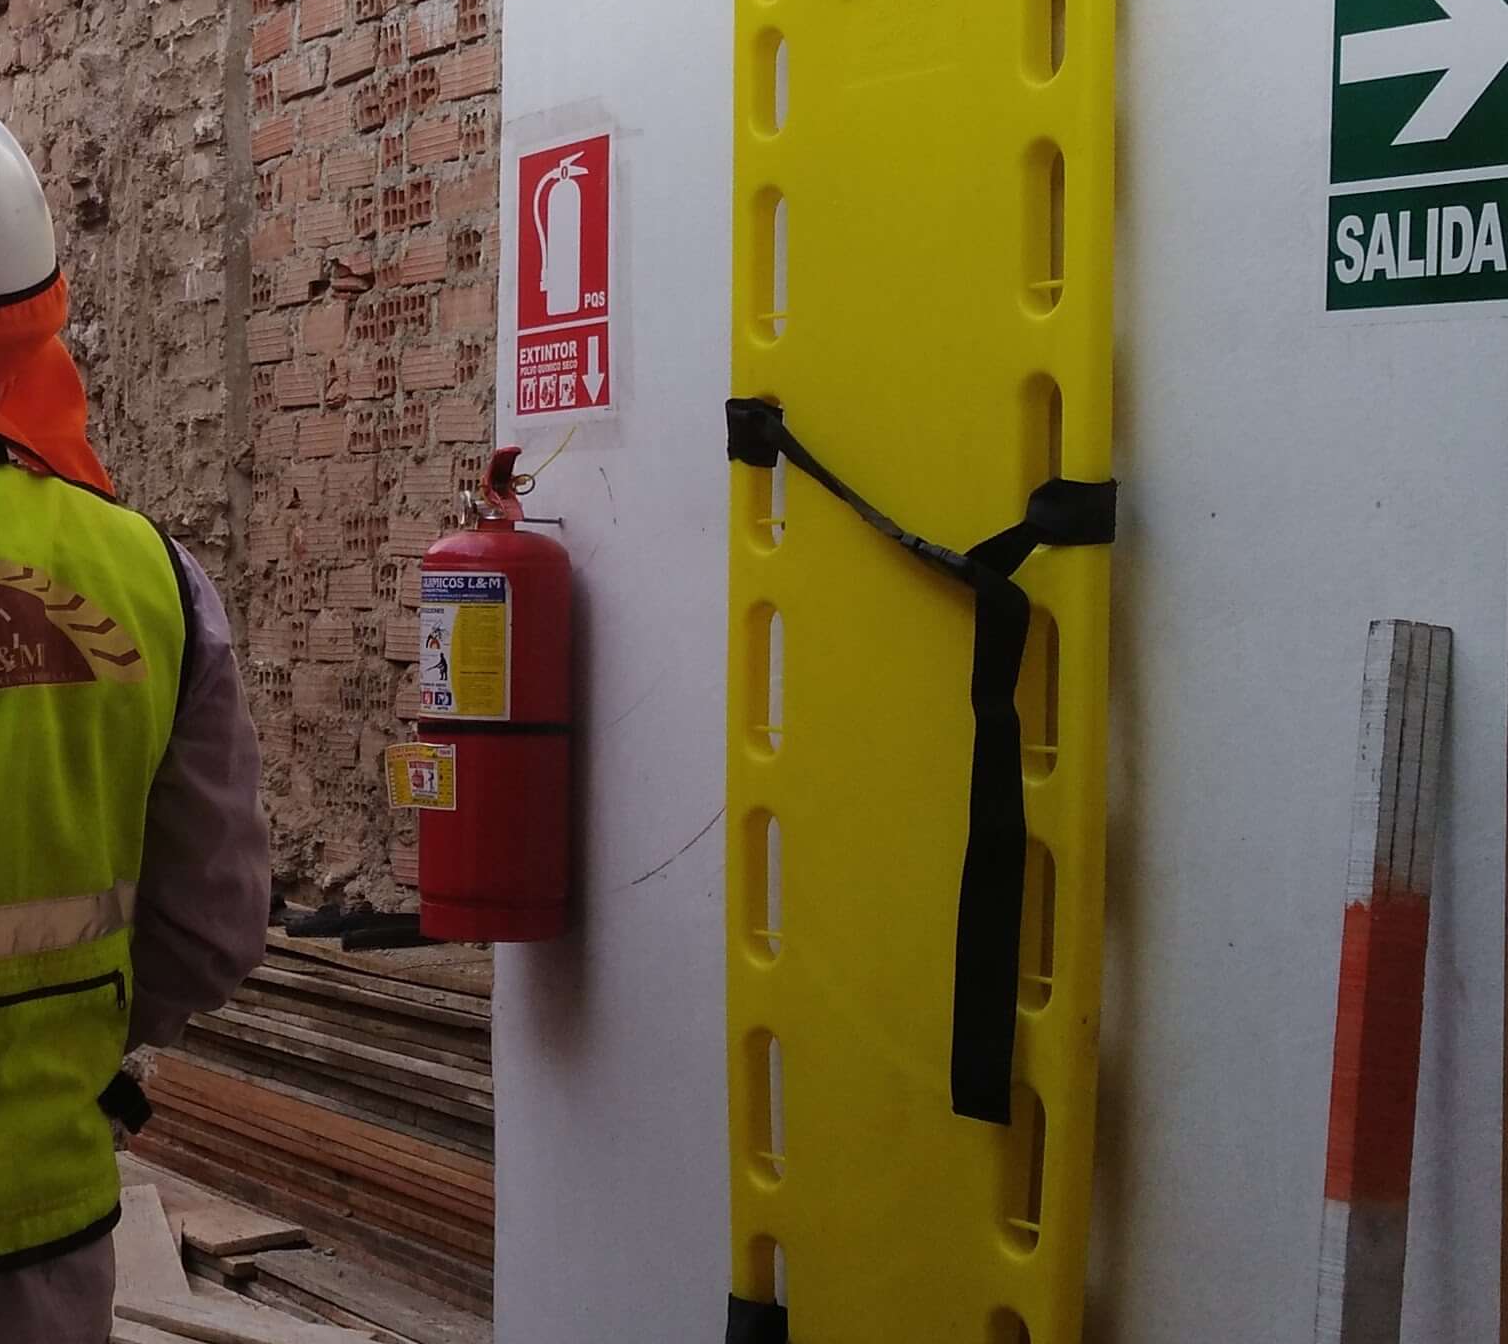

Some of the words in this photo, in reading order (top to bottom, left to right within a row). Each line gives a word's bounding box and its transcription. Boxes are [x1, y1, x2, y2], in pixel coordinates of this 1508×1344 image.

[1334, 202, 1507, 284] SALIDA
[584, 291, 606, 308] PQS
[519, 340, 578, 365] EXTINTOR
[467, 577, 501, 589] L&M
